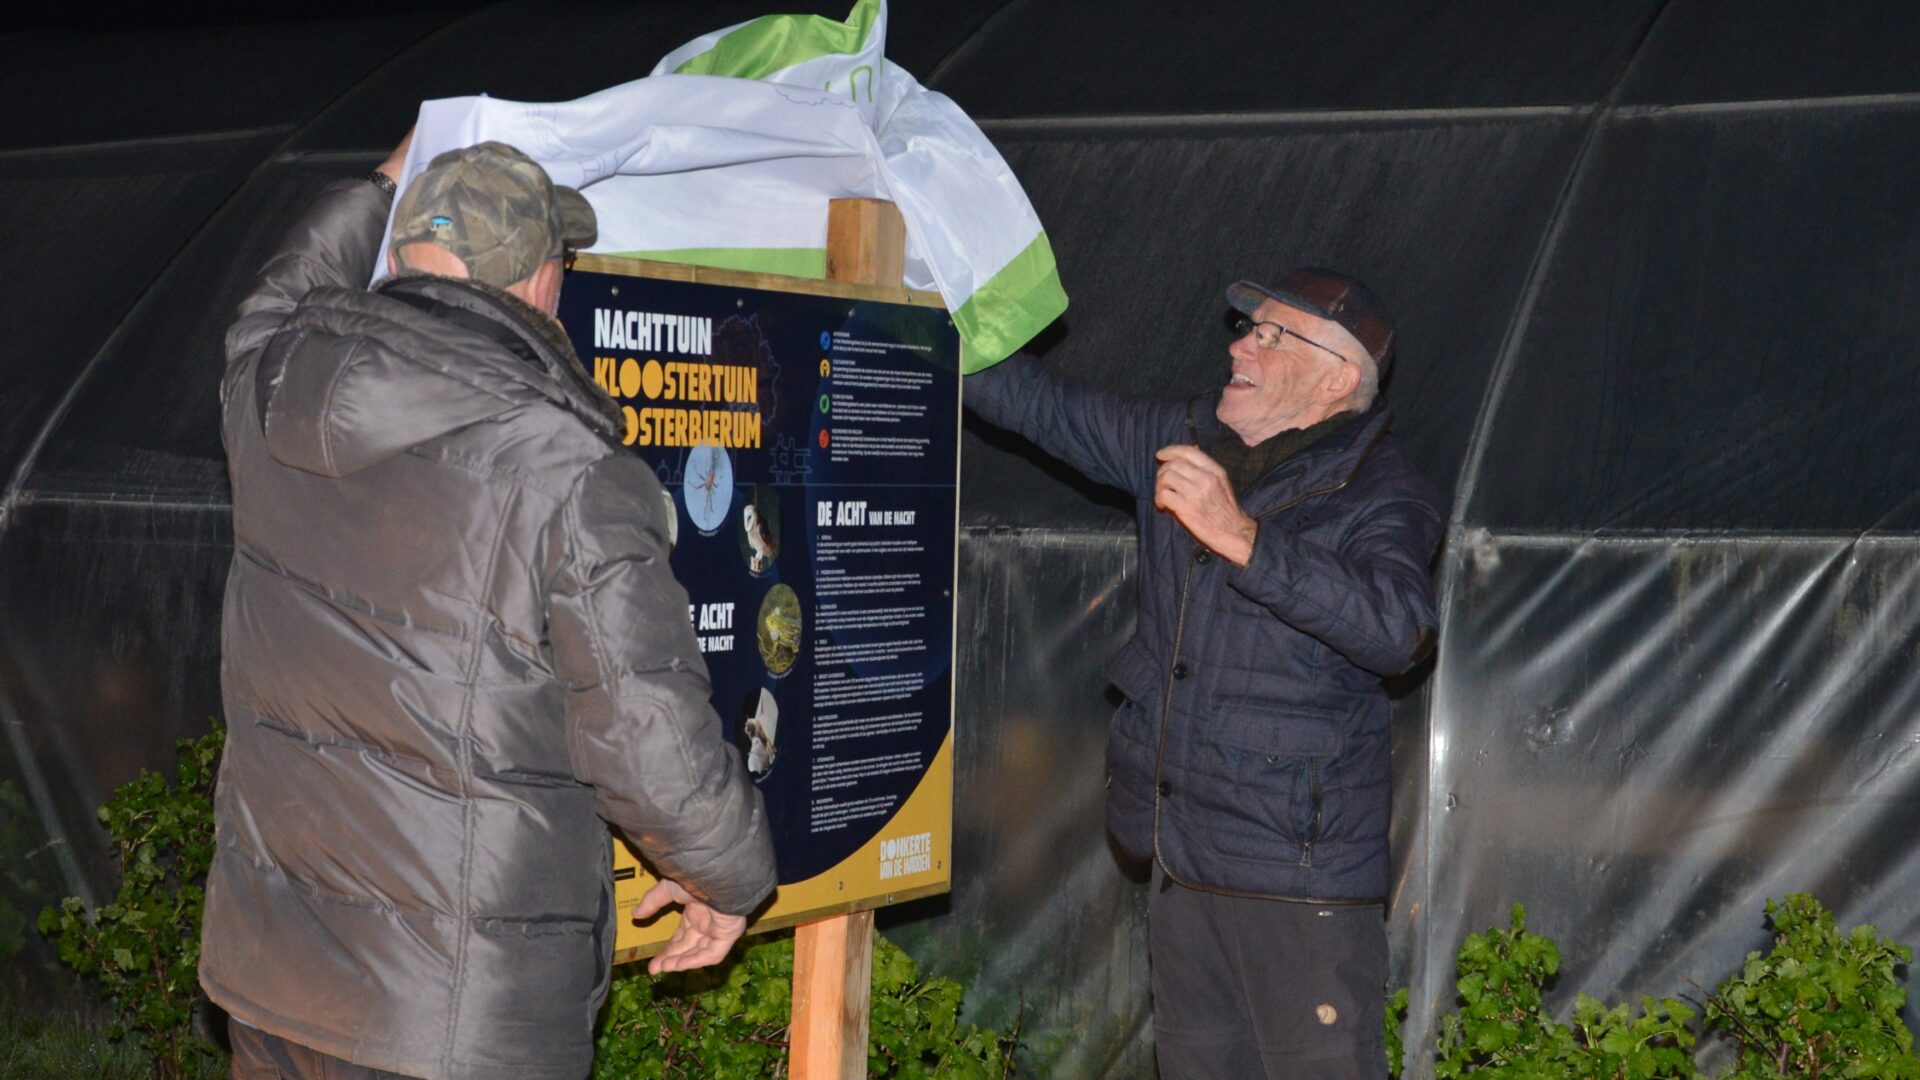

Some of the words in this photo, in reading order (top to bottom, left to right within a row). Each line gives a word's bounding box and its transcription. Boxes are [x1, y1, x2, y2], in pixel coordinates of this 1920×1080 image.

[594, 308, 712, 356] NACHTTUIN
[622, 405, 761, 449] OSTERBIERUM
[817, 501, 833, 526] DE
[836, 501, 868, 526] ACHT
[868, 511, 883, 525] VAN
[884, 511, 893, 525] DE
[893, 511, 916, 525] NACHT
[699, 602, 735, 631] ACHT
[708, 635, 735, 652] NACHT
[880, 832, 931, 860] DONKERTE
